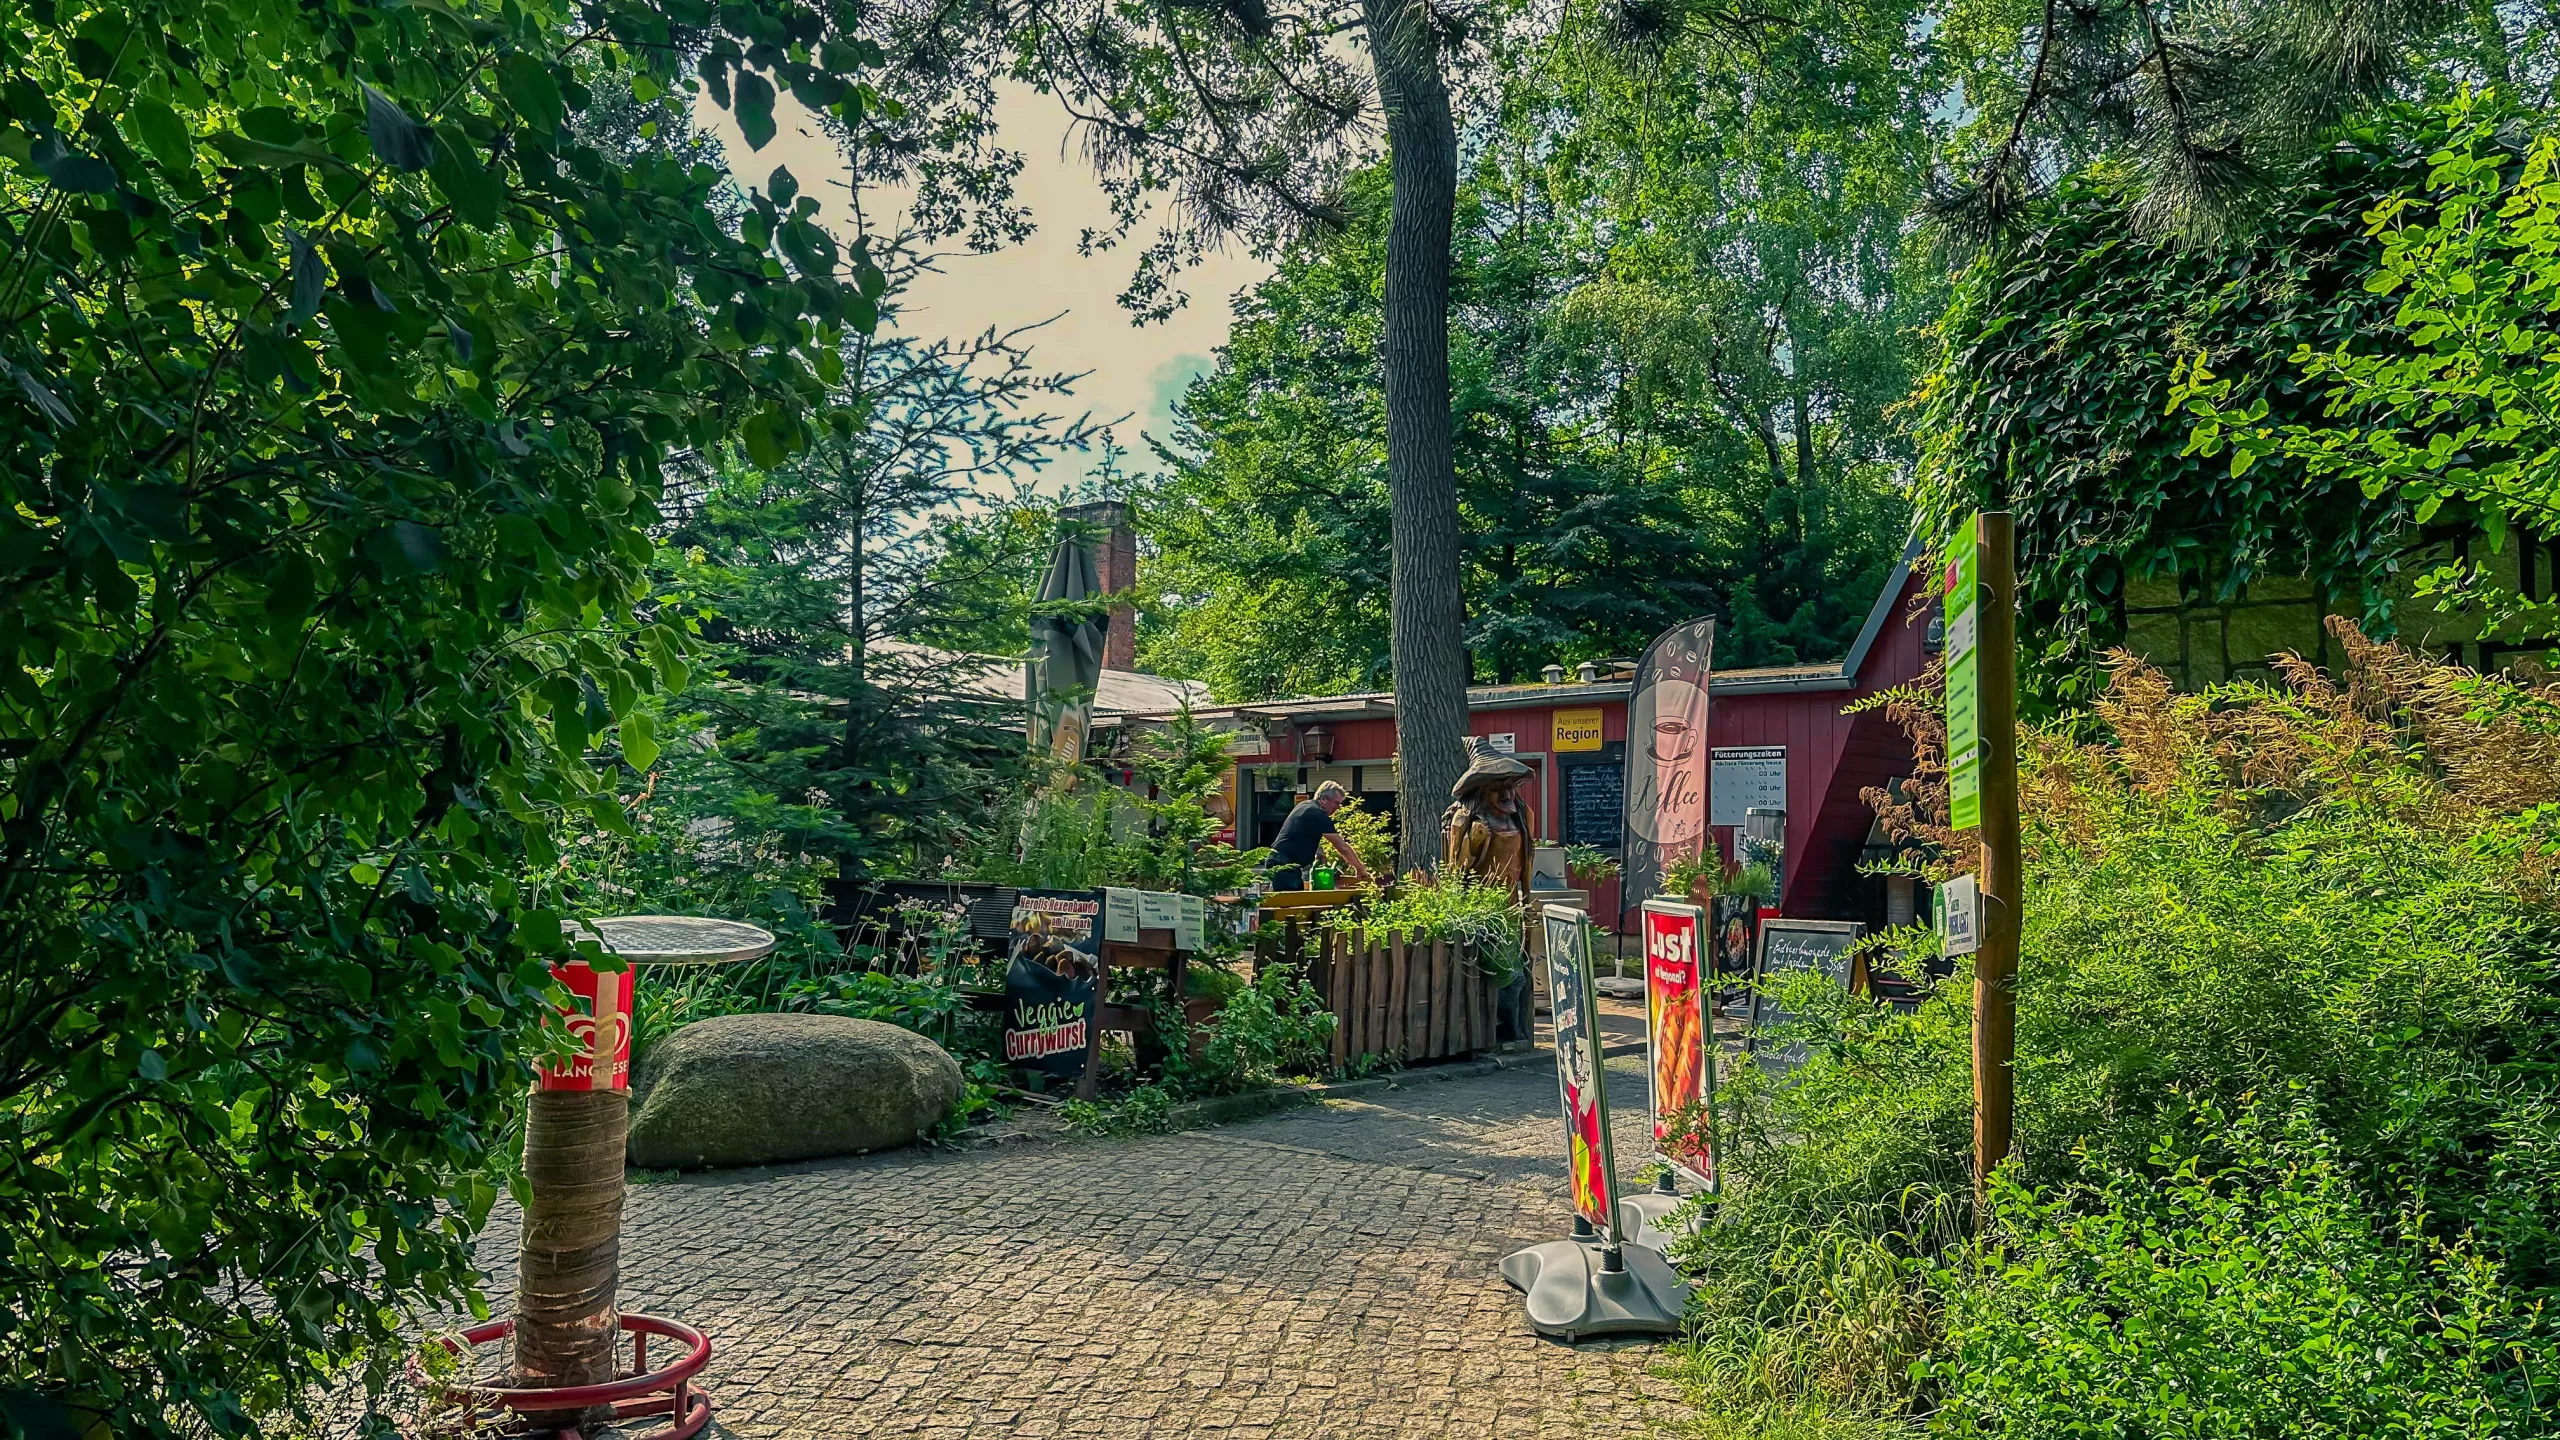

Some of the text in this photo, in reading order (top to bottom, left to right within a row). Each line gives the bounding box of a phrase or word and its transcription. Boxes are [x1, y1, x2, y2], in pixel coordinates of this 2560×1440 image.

[1557, 717, 1599, 726] Aus unserer
[1556, 725, 1599, 744] Region
[1714, 750, 1782, 760] Fütterungszeiten
[1048, 897, 1099, 915] Hexenbaude
[1051, 915, 1092, 931] am Tierpark
[1649, 918, 1692, 963] Lust
[1014, 996, 1073, 1036] Veggie
[1006, 1018, 1087, 1060] Currywurst
[552, 1060, 628, 1078] LANESE
